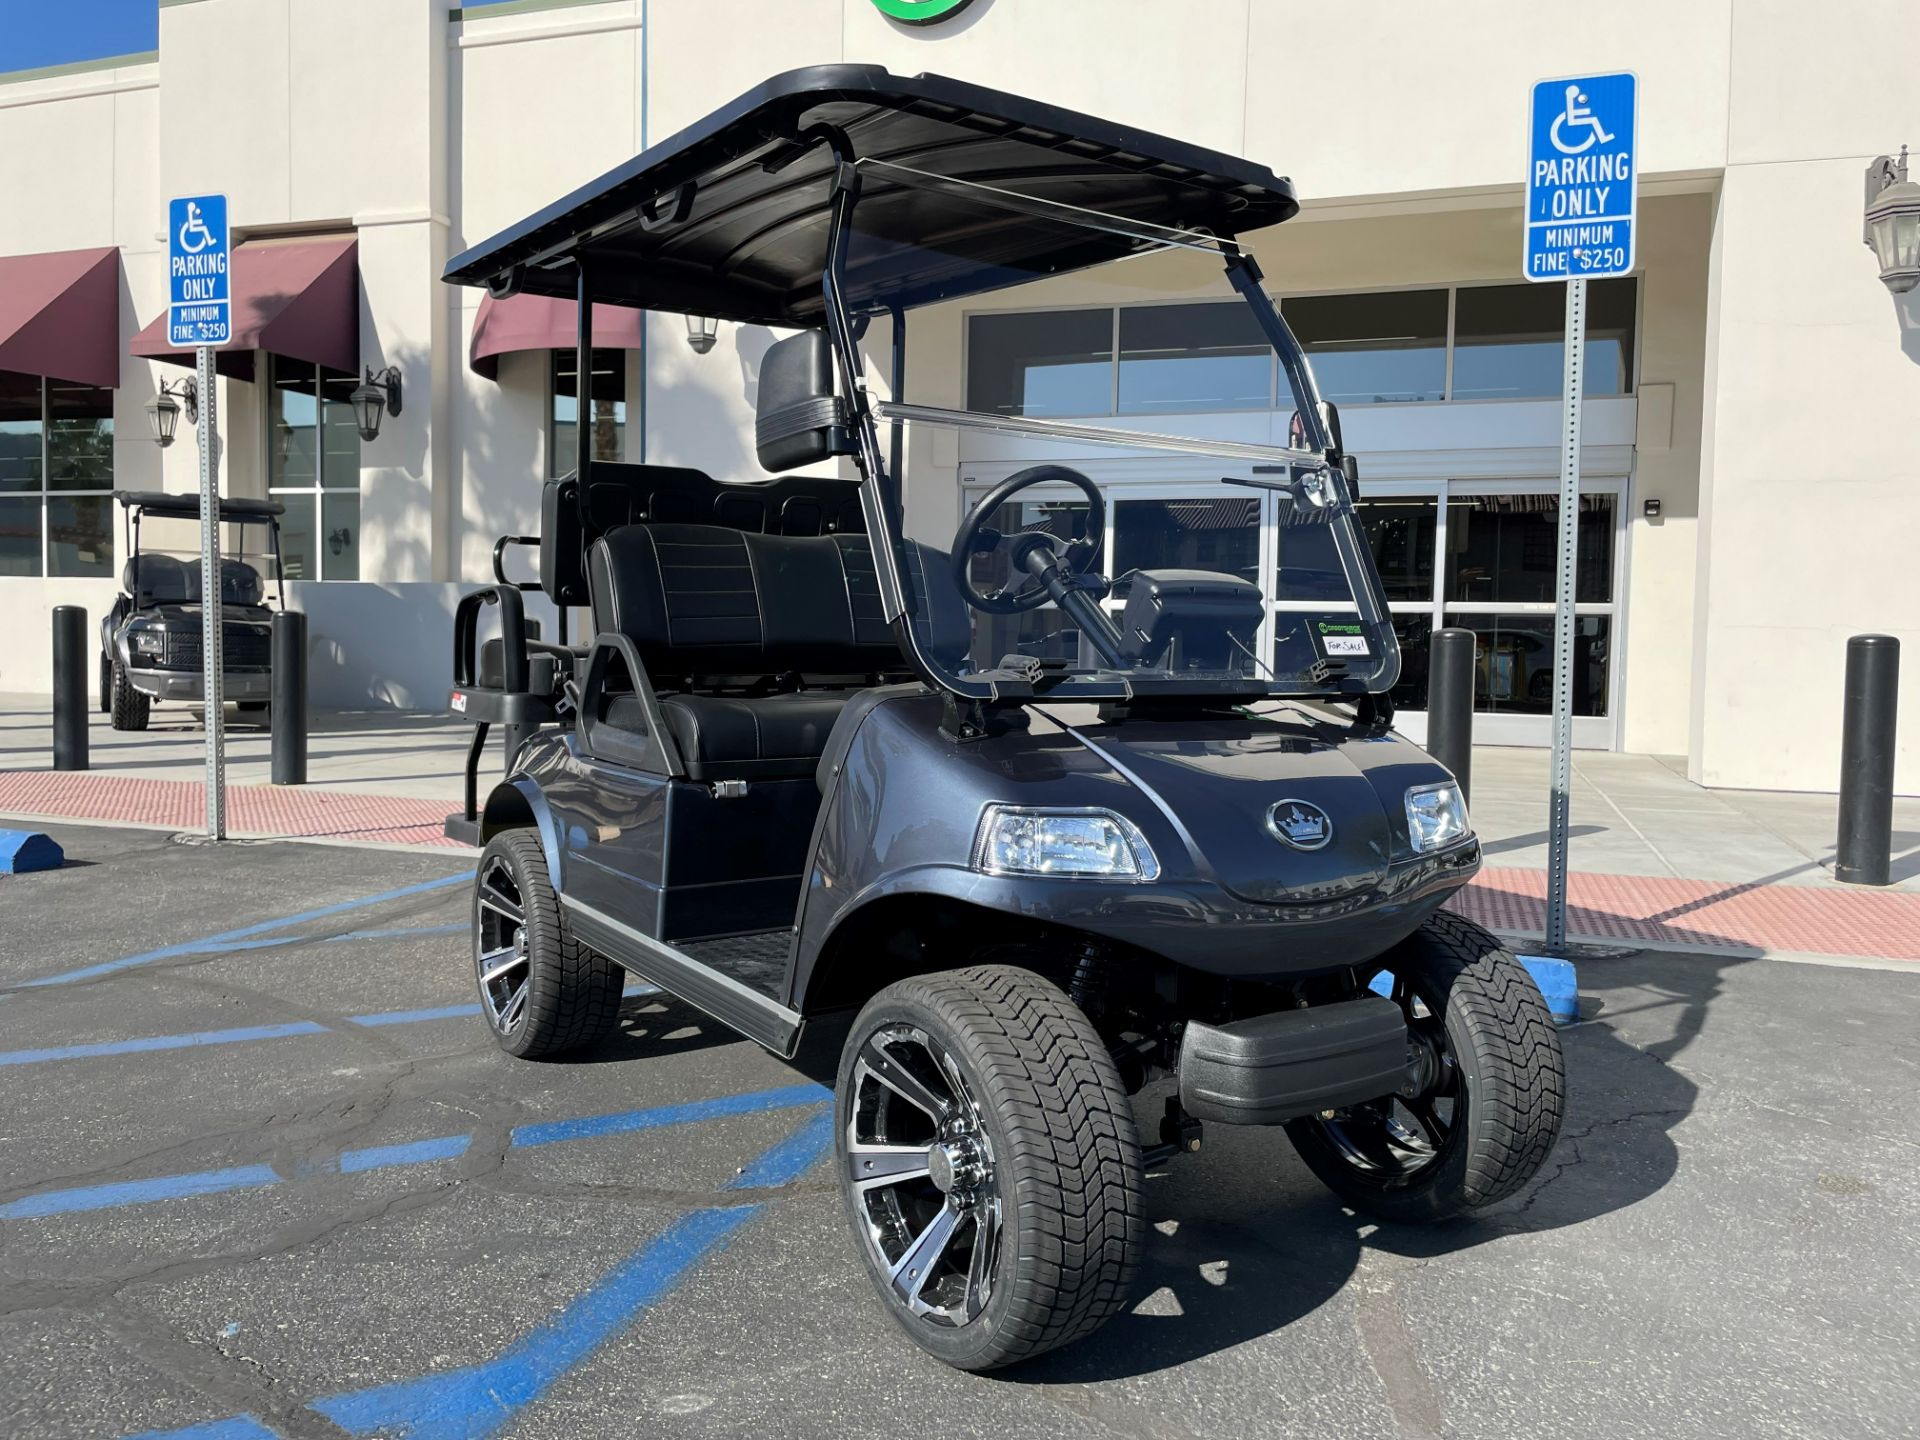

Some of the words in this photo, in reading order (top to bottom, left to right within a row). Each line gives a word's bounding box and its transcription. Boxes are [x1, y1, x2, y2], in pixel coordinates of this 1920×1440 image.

[1535, 152, 1629, 187] PARKING
[1552, 186, 1610, 217] ONLY
[1545, 225, 1613, 248] MINIMUM
[172, 252, 226, 277] PARKING
[1534, 252, 1567, 272] FINE
[1580, 247, 1624, 271] $250
[183, 277, 216, 300] ONLY
[181, 306, 219, 322] MINIMUM
[173, 324, 194, 340] FINE
[201, 322, 226, 339] $250
